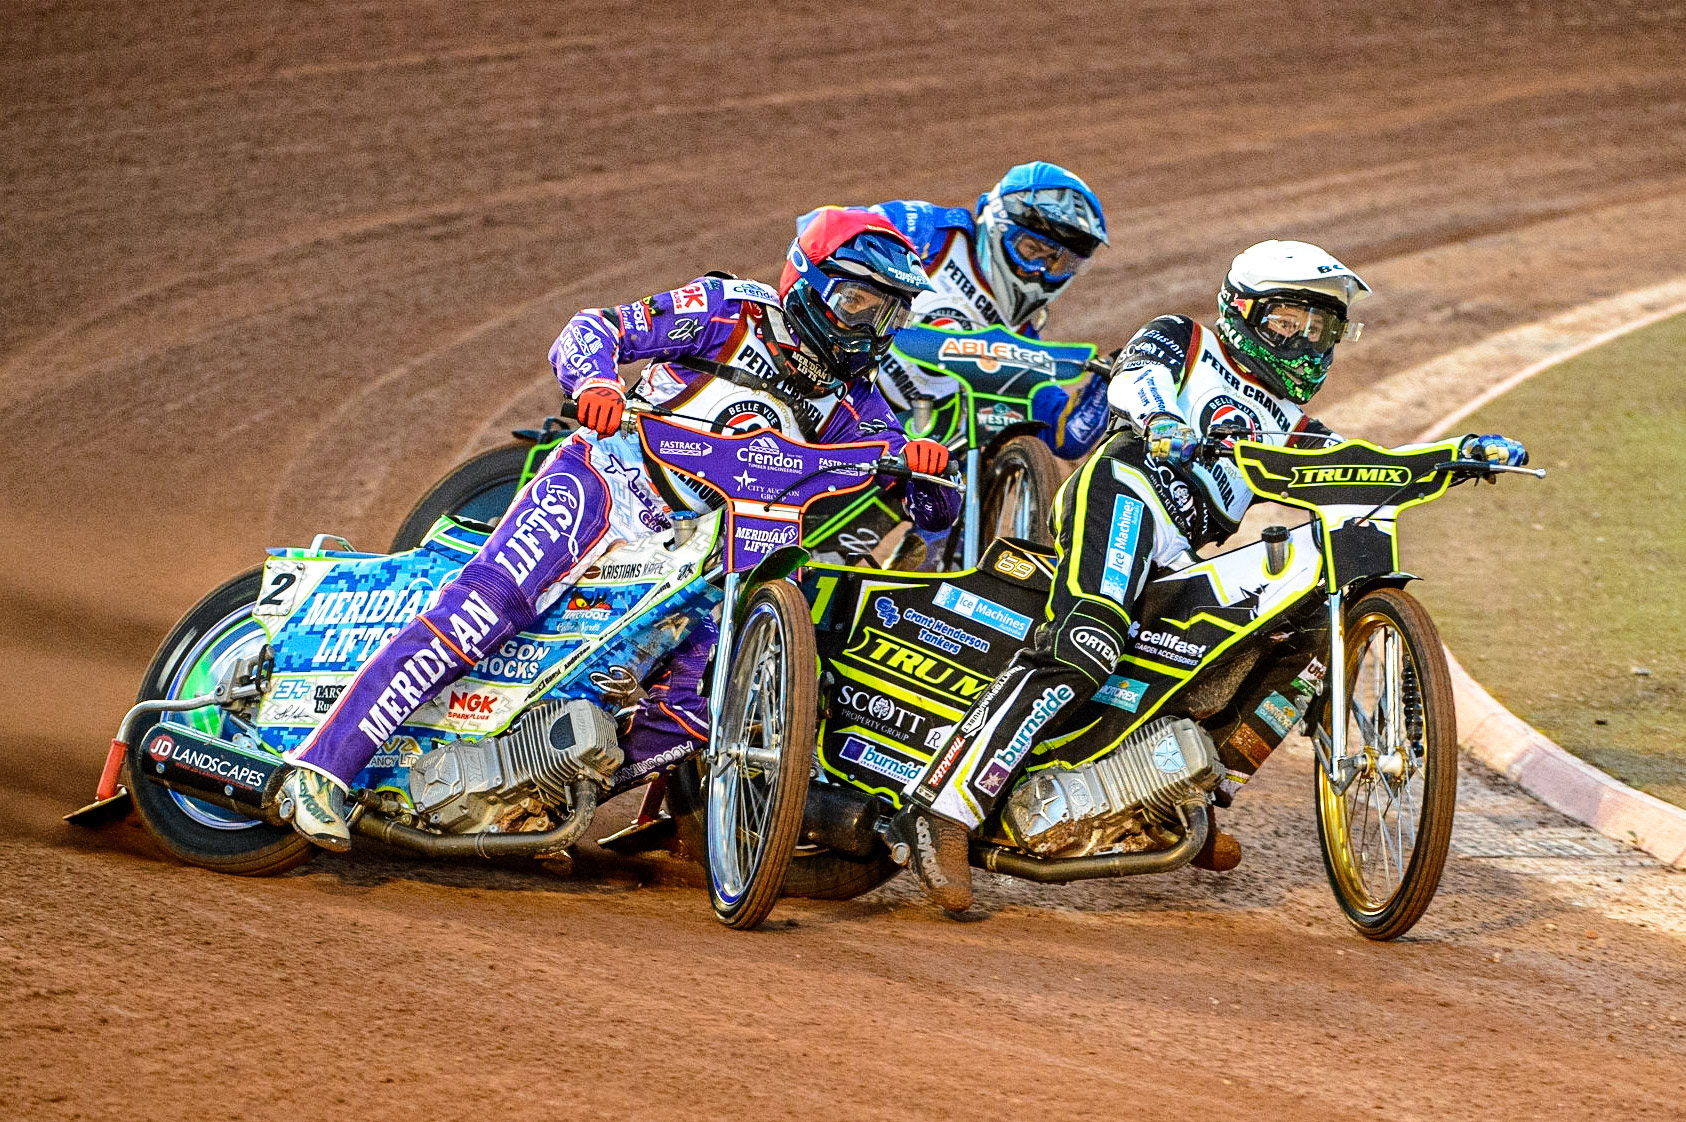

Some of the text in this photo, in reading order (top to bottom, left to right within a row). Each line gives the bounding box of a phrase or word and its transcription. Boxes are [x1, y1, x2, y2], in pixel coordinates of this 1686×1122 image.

[944, 259, 1005, 325] PETER CRAV
[792, 351, 827, 380] MERIDIAN
[1201, 350, 1291, 432] PETER CRAVEN
[729, 402, 778, 427] BELLE VUE
[1209, 397, 1256, 418] BELLE VUE
[660, 441, 701, 450] FASTRACK
[736, 448, 803, 469] Crendon
[748, 463, 803, 474] TIMBER ENGINEERING
[1302, 469, 1403, 483] TRU MIX
[748, 484, 800, 497] CITY AUCION
[760, 493, 787, 502] GROP
[1212, 464, 1235, 512] ORIAL
[495, 493, 573, 586] LIFTS
[735, 527, 788, 543] MERIDIAN
[744, 540, 775, 554] LIFTS
[1112, 500, 1135, 572] Ice Machines
[601, 564, 641, 579] KRISTIANS
[996, 552, 1036, 579] 69
[260, 573, 297, 605] 2
[811, 577, 838, 624] 1
[959, 591, 1026, 631] Ice Machines
[904, 609, 990, 653] Grant Henderson
[918, 629, 962, 654] Tankers
[869, 638, 954, 683] TRU
[1134, 642, 1158, 657] GARDEN
[358, 591, 500, 748] MERIDIAN
[474, 657, 540, 679] HOCKS
[450, 691, 498, 714] NGK
[1100, 685, 1138, 703] MOTOREX
[448, 712, 470, 721] SPARK
[837, 686, 926, 734] SCOTT
[841, 708, 909, 742] PROPERTY GROUP
[998, 687, 1073, 766] burnside
[149, 738, 265, 787] JD LANDSCAPES
[613, 741, 694, 784] ACCOUNTANC
[864, 747, 921, 780] burnsid
[928, 735, 966, 788] makita
